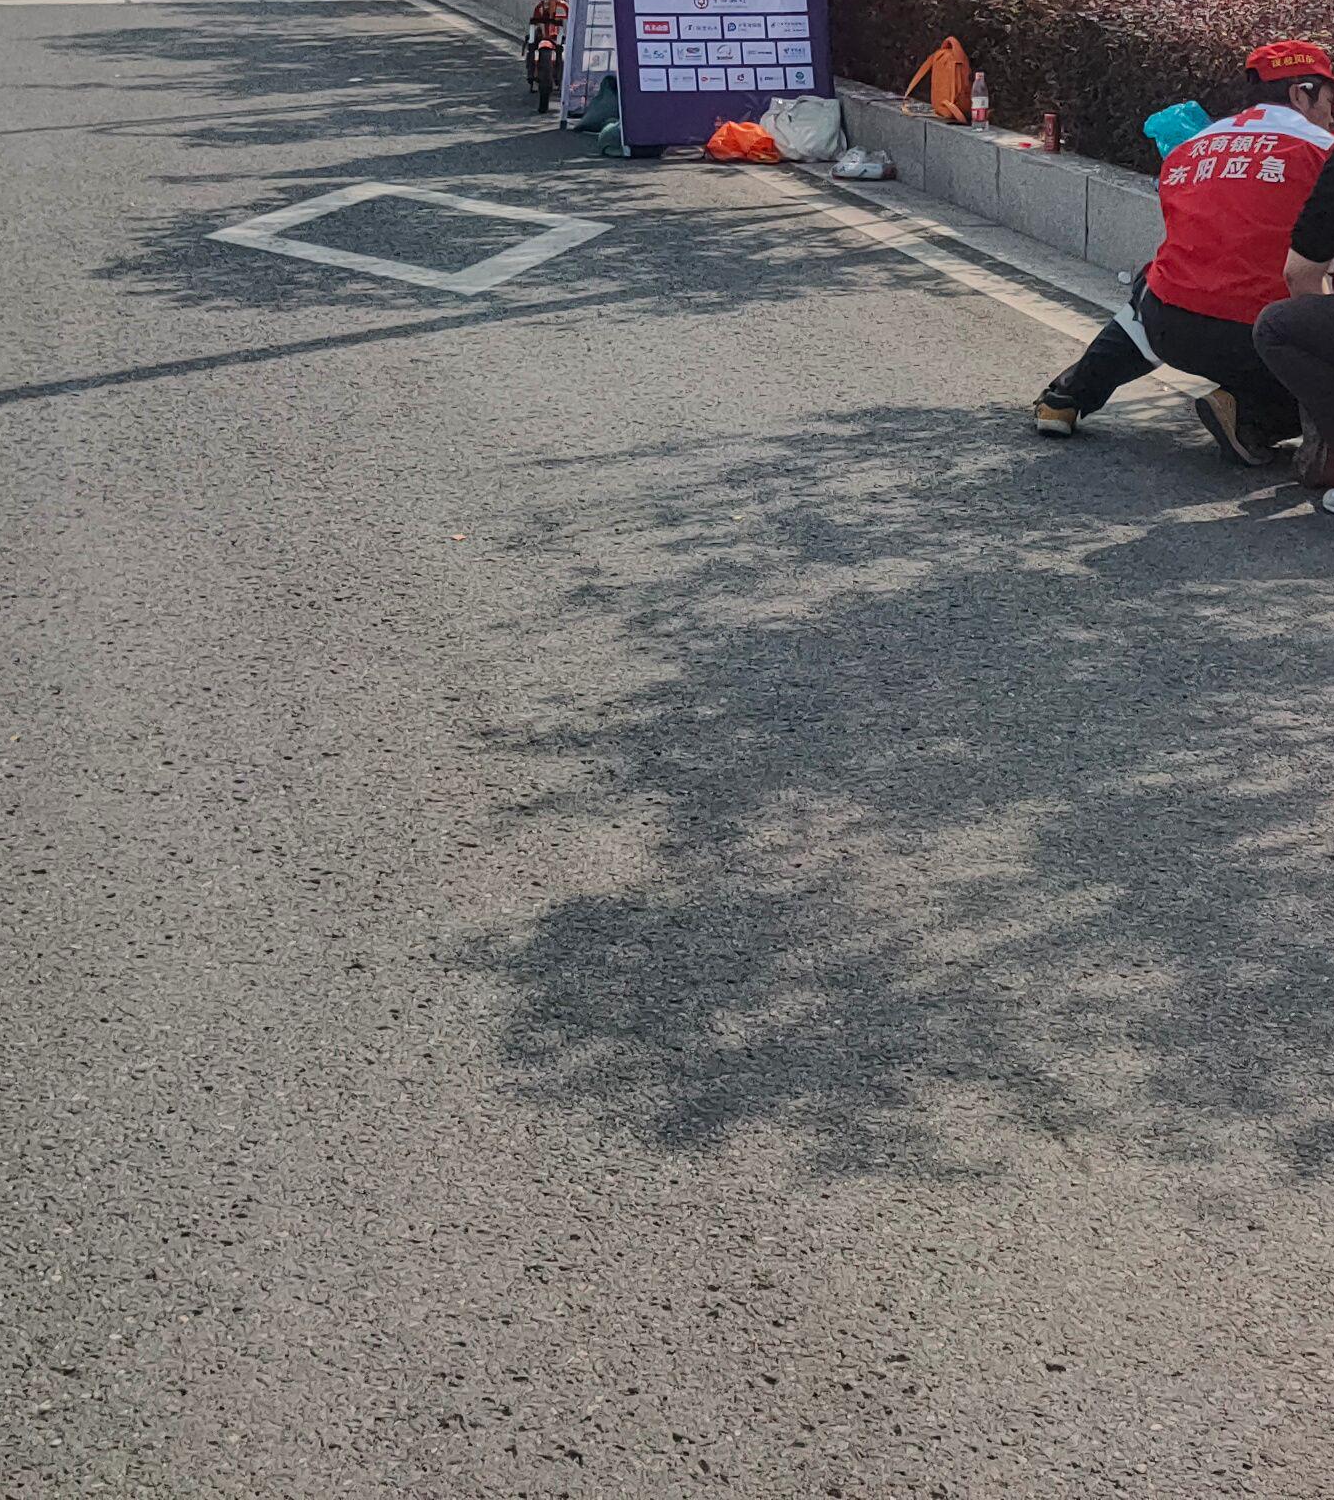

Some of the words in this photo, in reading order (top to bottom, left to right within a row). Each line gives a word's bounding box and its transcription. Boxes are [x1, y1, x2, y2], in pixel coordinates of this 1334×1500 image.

[1188, 134, 1278, 158] 农商银行
[1163, 156, 1285, 185] 东阳应急
